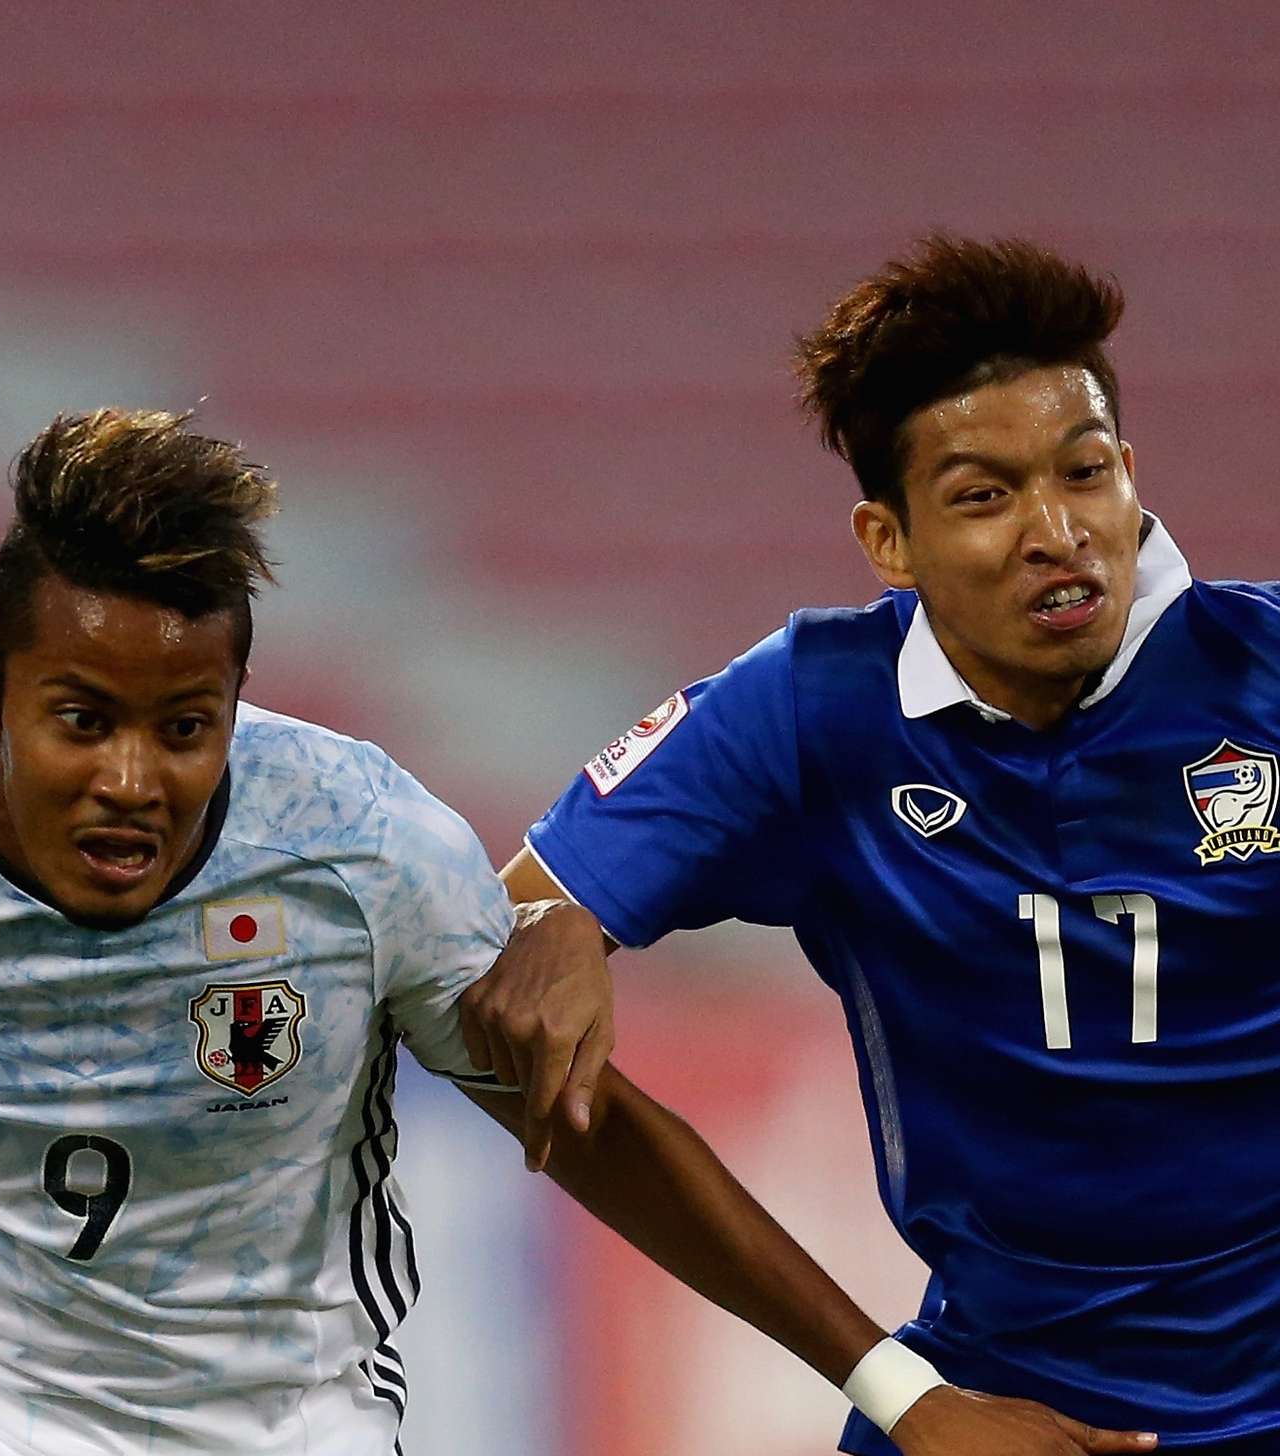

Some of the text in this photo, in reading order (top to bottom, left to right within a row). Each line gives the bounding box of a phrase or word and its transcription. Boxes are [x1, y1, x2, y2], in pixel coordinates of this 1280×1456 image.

[1209, 829, 1272, 850] THAILAND
[1018, 893, 1159, 1050] 17
[206, 1095, 290, 1114] JAPAN
[43, 1133, 133, 1262] 9
